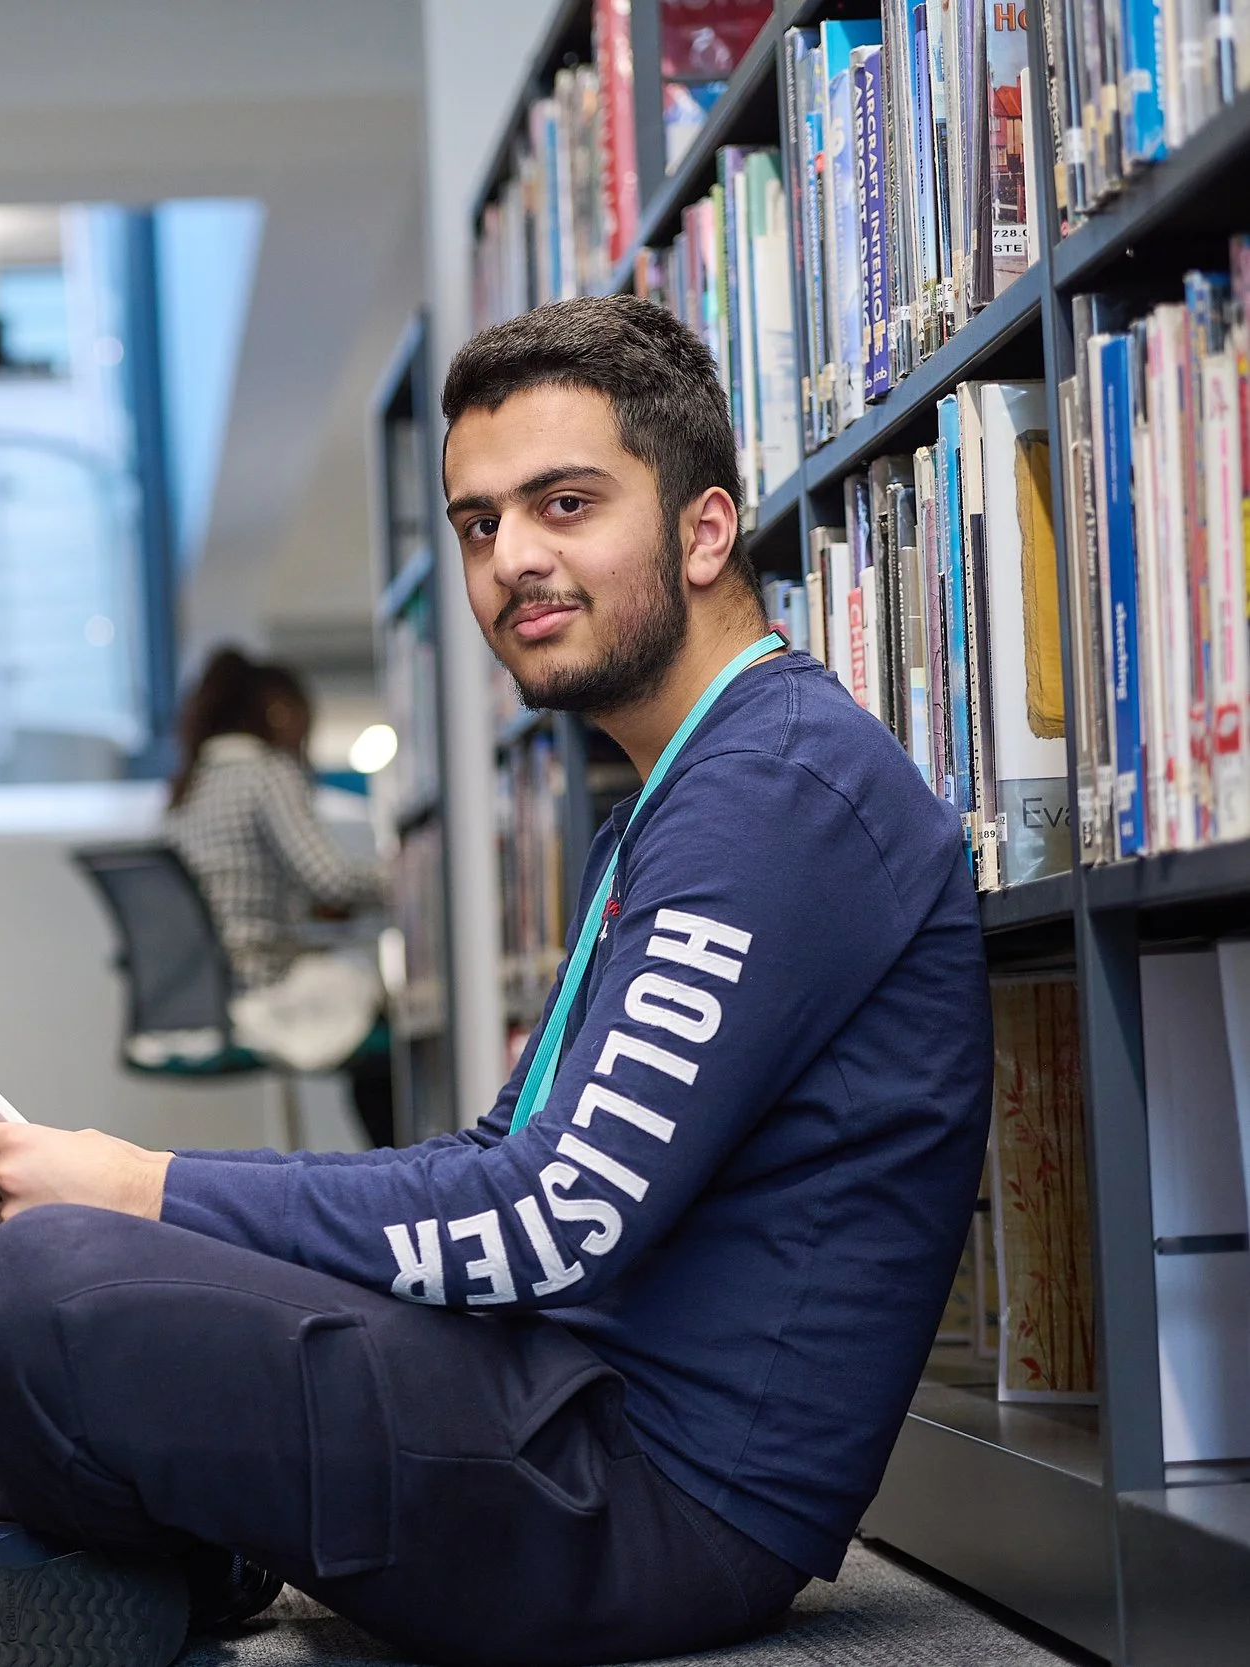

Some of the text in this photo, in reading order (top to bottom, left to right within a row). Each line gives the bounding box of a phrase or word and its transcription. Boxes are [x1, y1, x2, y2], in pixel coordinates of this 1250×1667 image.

[854, 85, 868, 223] AIRPORT
[1050, 77, 1062, 144] Herbert
[864, 70, 883, 356] AIRCRAFT INTERIOS
[993, 244, 1022, 253] STE
[940, 436, 951, 558] Celebrating
[1115, 602, 1129, 701] sketching
[383, 908, 753, 1307] HOLLISTER
